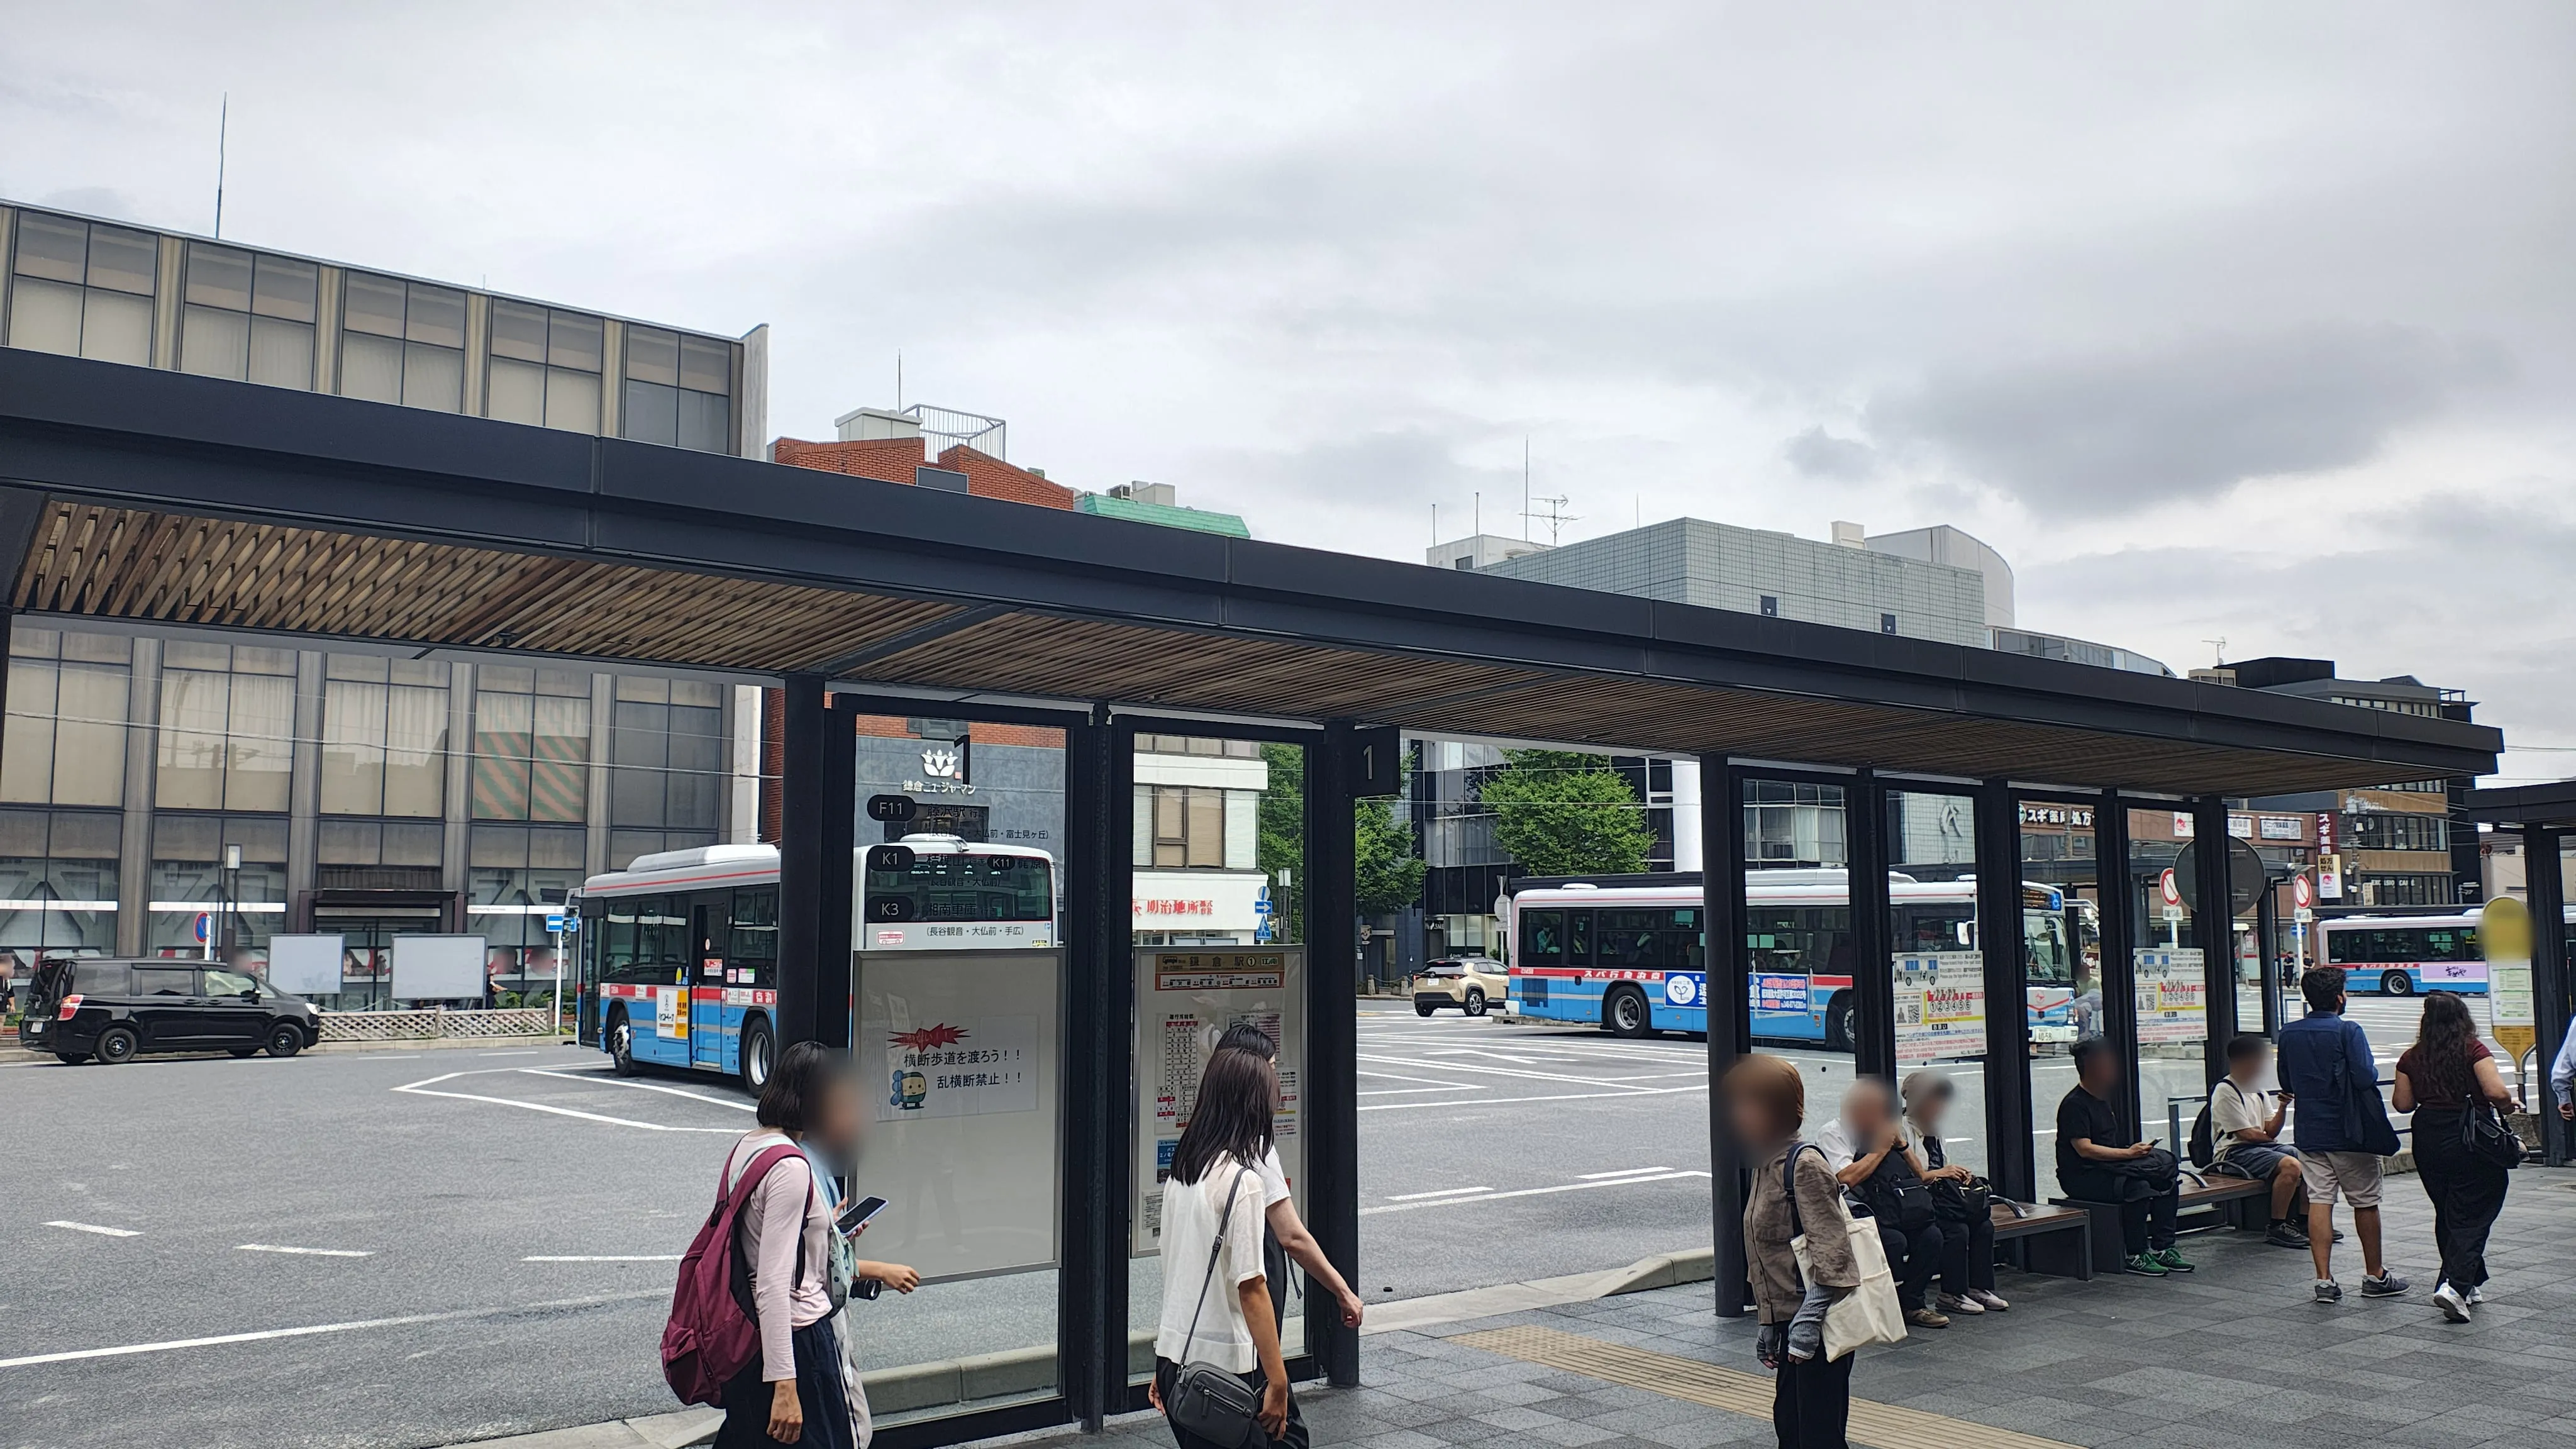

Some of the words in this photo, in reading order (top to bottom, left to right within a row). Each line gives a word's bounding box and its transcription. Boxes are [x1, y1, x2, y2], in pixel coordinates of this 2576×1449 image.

[953, 735, 970, 784] 1
[1363, 745, 1372, 779] 1
[902, 779, 975, 795] 鎌倉ニュージャーマン
[879, 802, 902, 814] F11
[2072, 810, 2095, 826] 処方
[882, 852, 898, 865] K1
[992, 858, 1010, 867] K11
[882, 904, 899, 916] K3
[1146, 900, 1199, 914] 明治地所
[926, 926, 1024, 936] (長谷観音・大仏前・手広)
[756, 991, 776, 1003] 京浜
[904, 1049, 1020, 1068] 横断歩道を渡ろう！！
[937, 1072, 1021, 1089] 乱横断禁止！！
